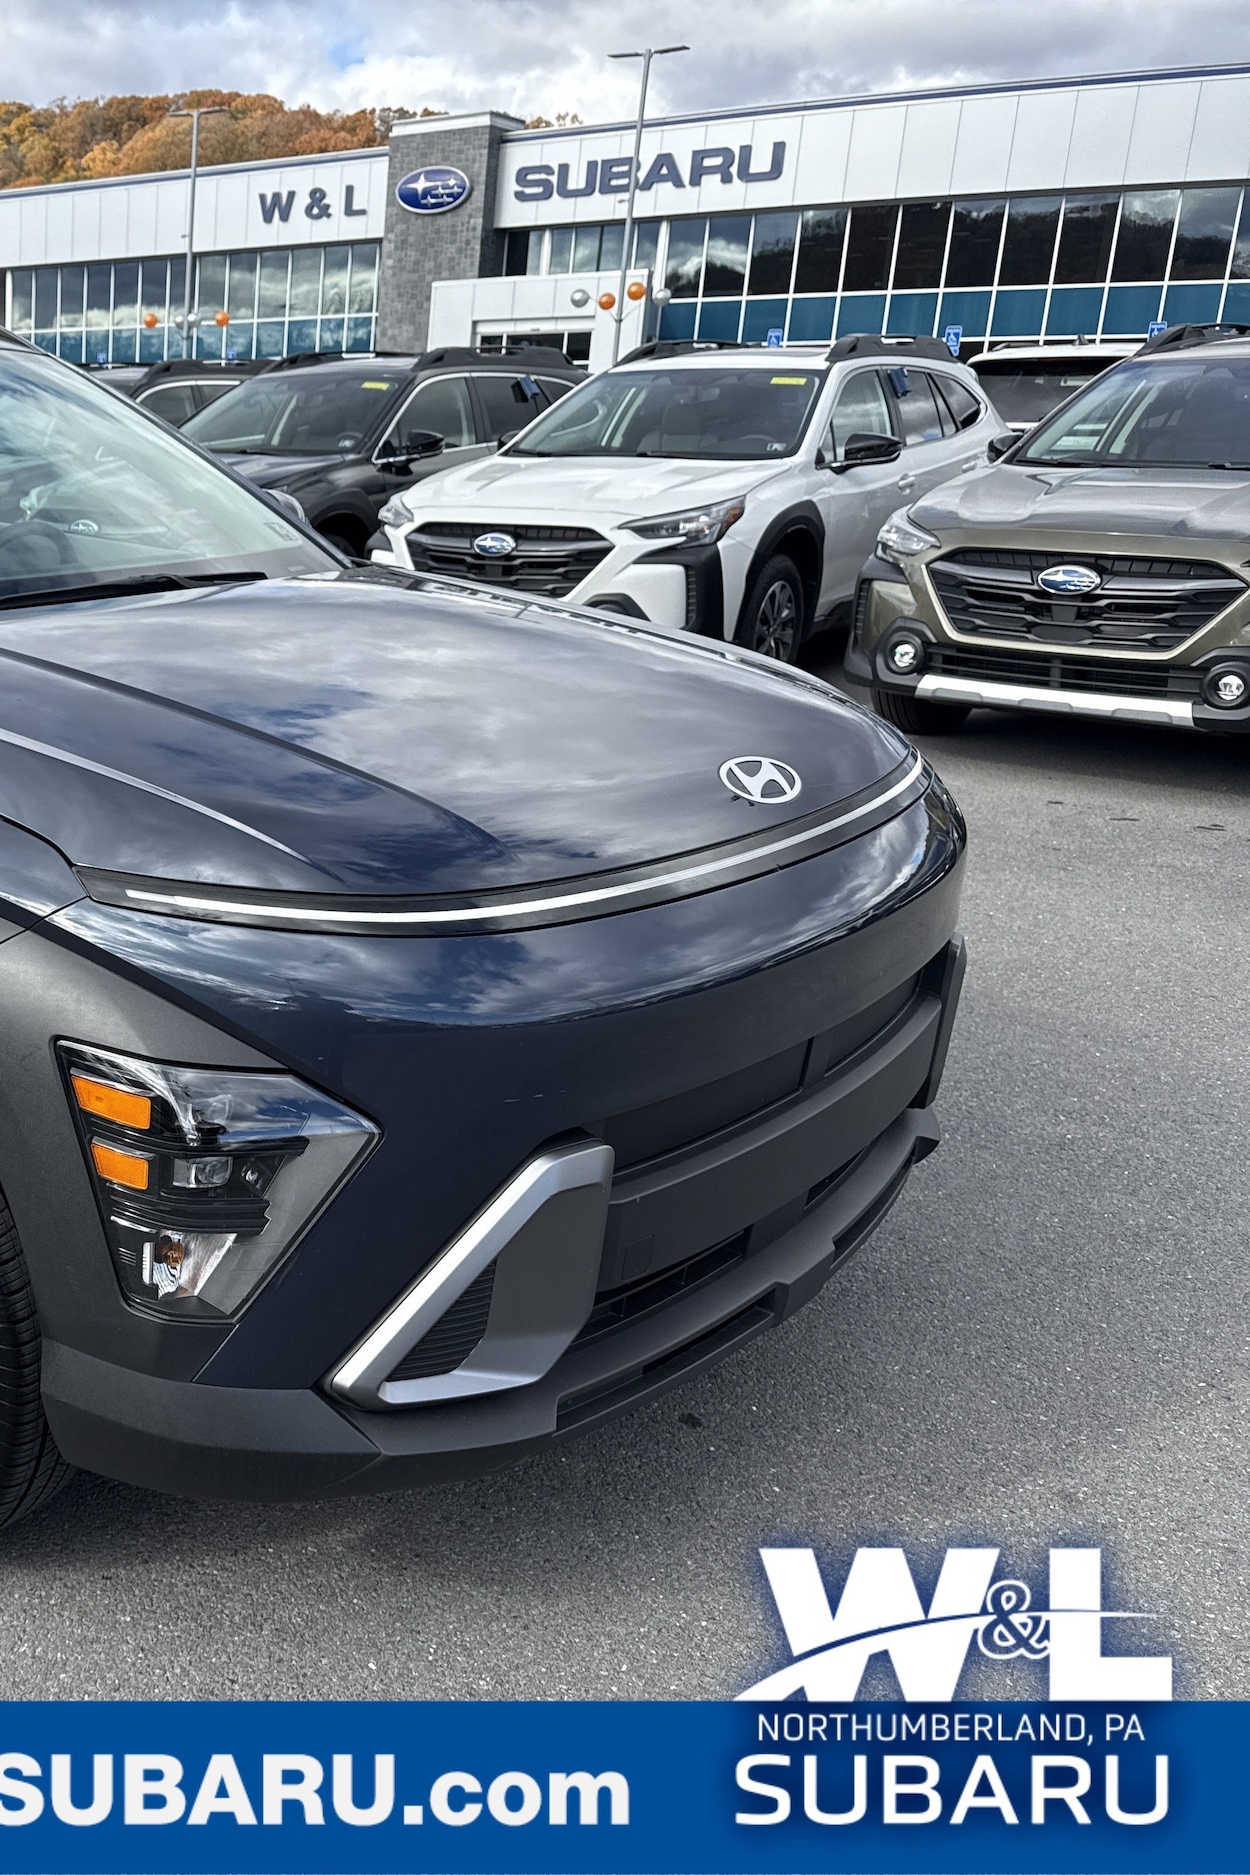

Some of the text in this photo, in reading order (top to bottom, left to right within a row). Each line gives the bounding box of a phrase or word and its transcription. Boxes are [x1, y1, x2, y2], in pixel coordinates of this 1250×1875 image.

[514, 141, 787, 202] SUBARU
[258, 184, 367, 224] W & L
